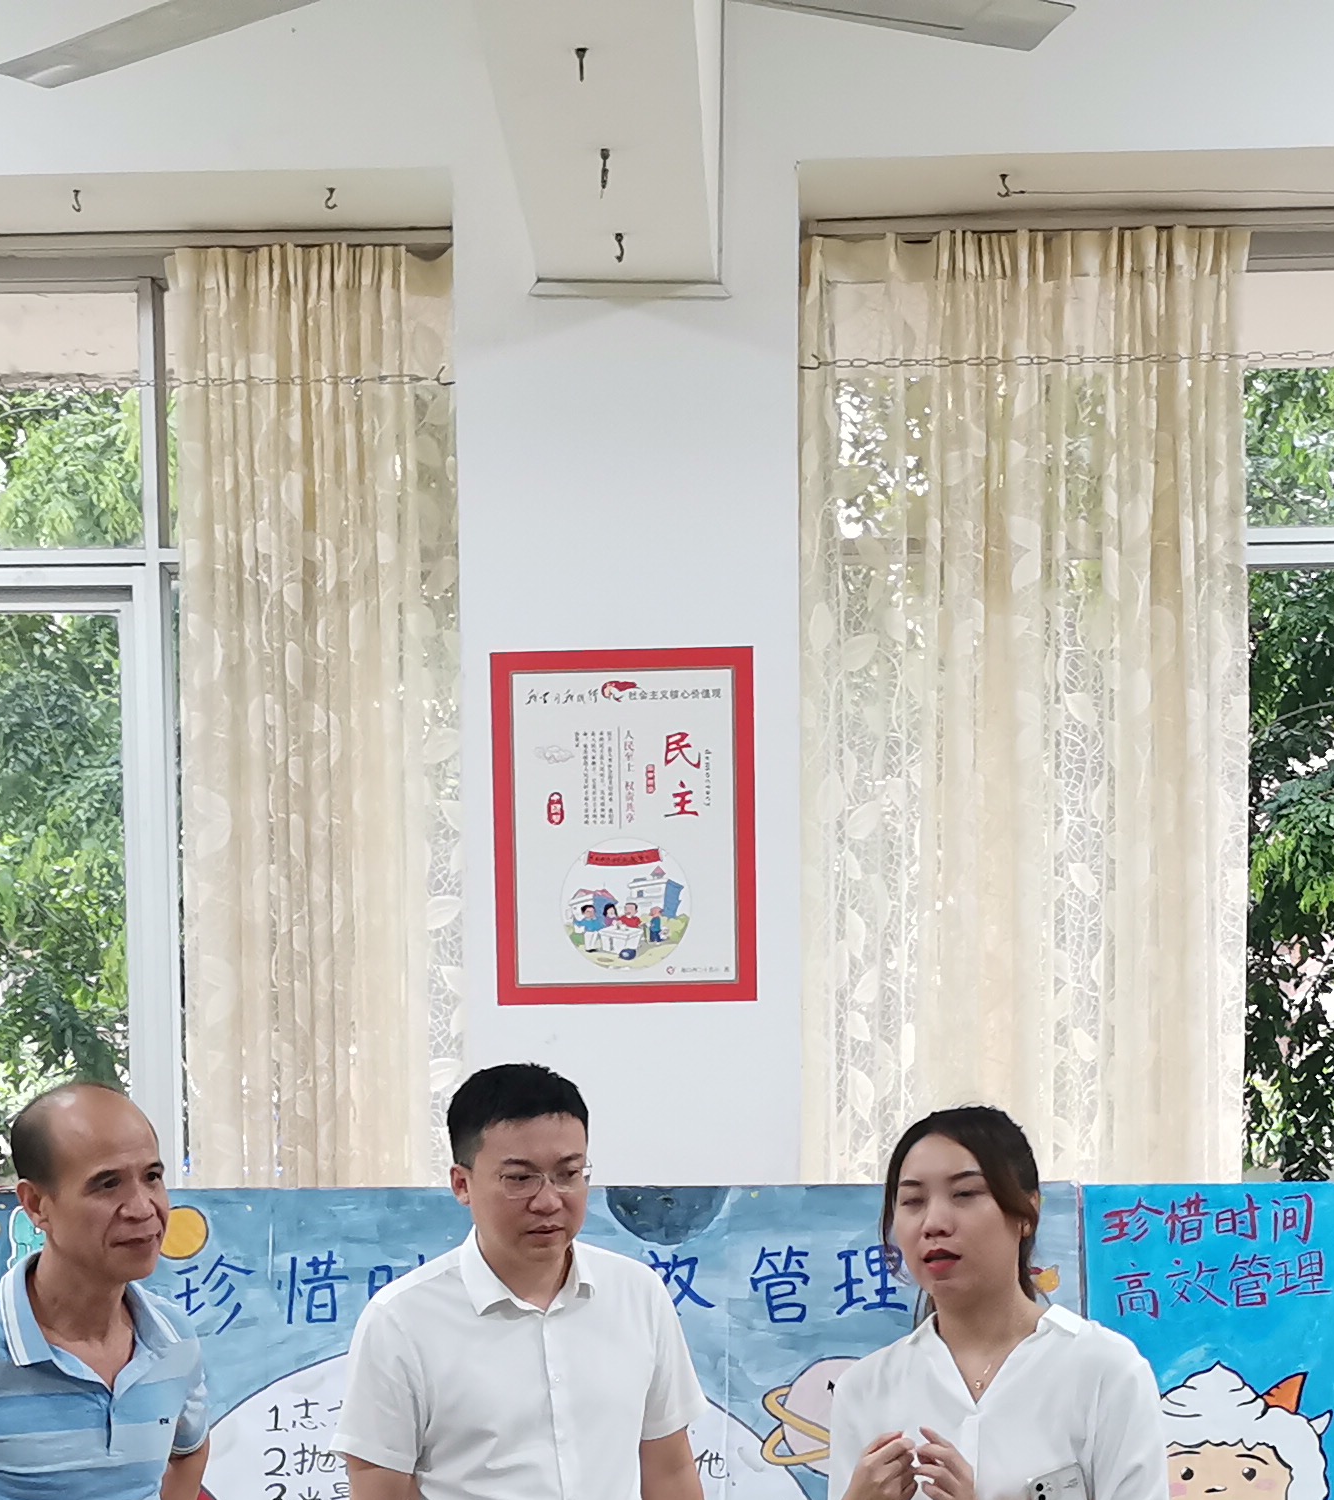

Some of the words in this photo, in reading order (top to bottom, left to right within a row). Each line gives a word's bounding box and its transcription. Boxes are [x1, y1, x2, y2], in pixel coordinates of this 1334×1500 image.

[664, 731, 702, 818] 民主
[1101, 1192, 1314, 1245] 珍惜时间
[1113, 1250, 1333, 1319] 高效管理
